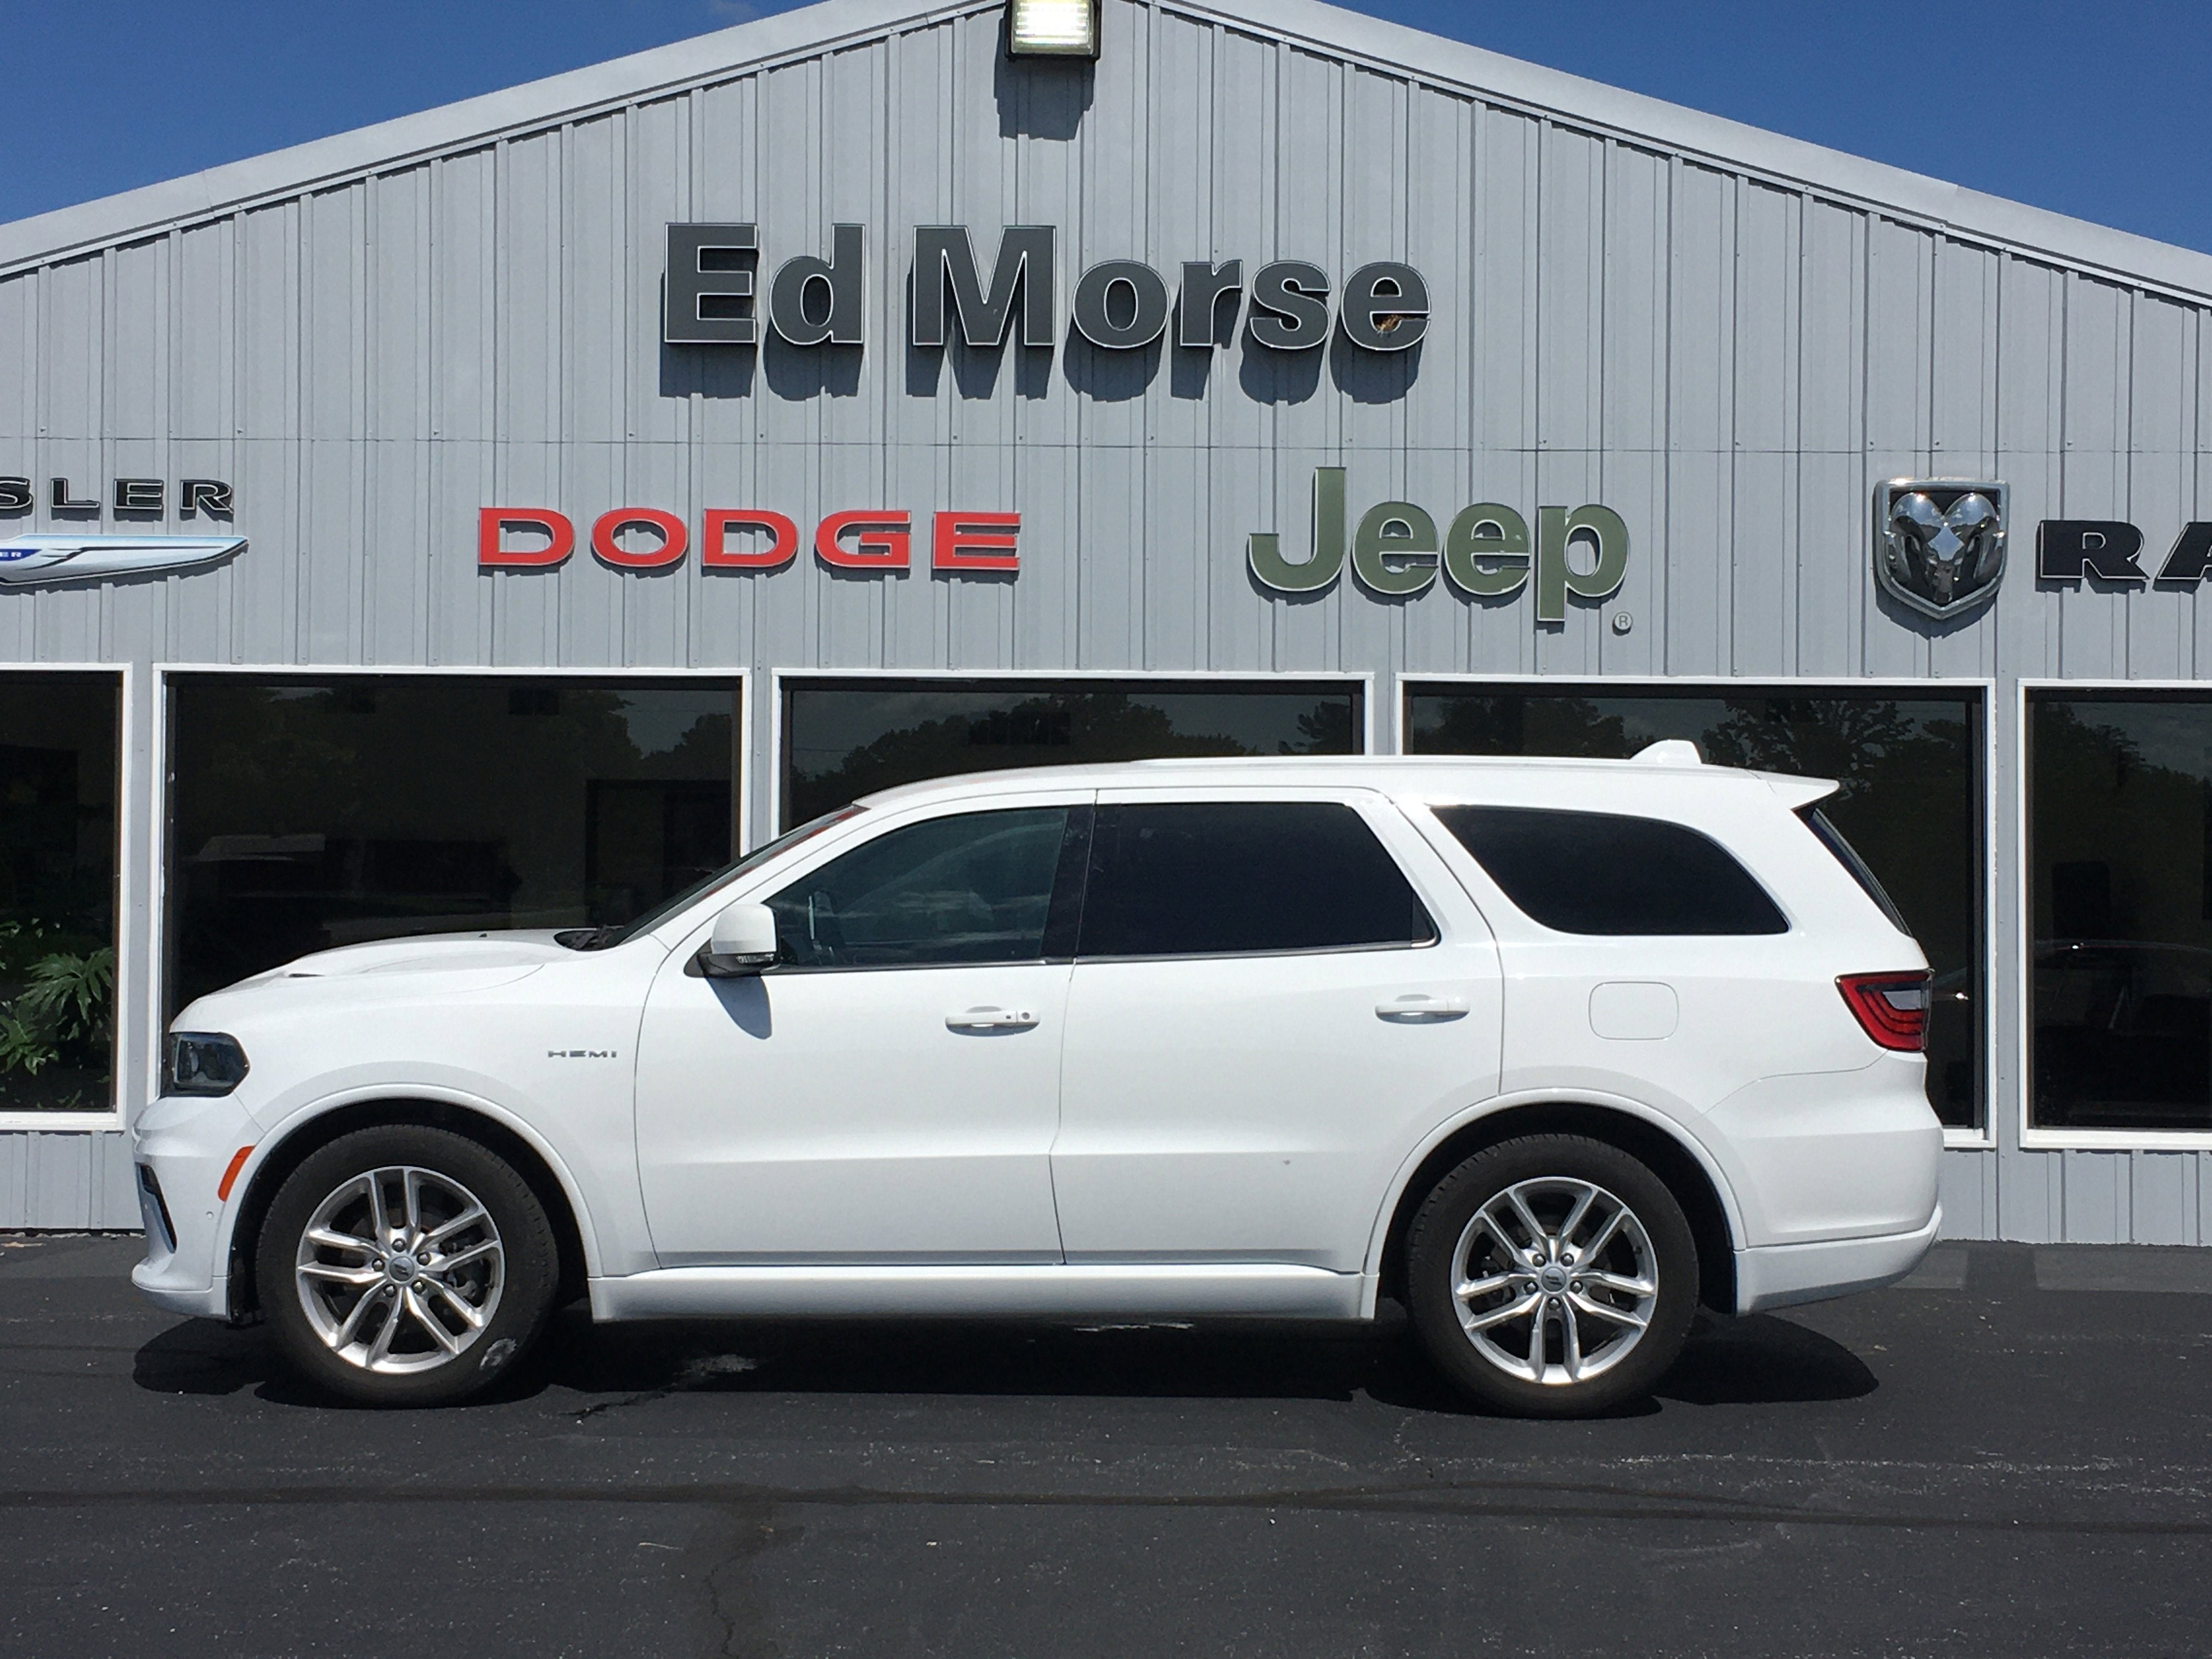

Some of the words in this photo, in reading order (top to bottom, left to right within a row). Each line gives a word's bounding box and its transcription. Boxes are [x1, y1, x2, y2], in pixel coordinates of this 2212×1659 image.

[664, 222, 865, 345] Ed
[912, 224, 1431, 351] Morse
[478, 507, 1021, 571] DODGE
[1248, 466, 1630, 622] Jeep
[548, 1050, 617, 1058] HEMI
